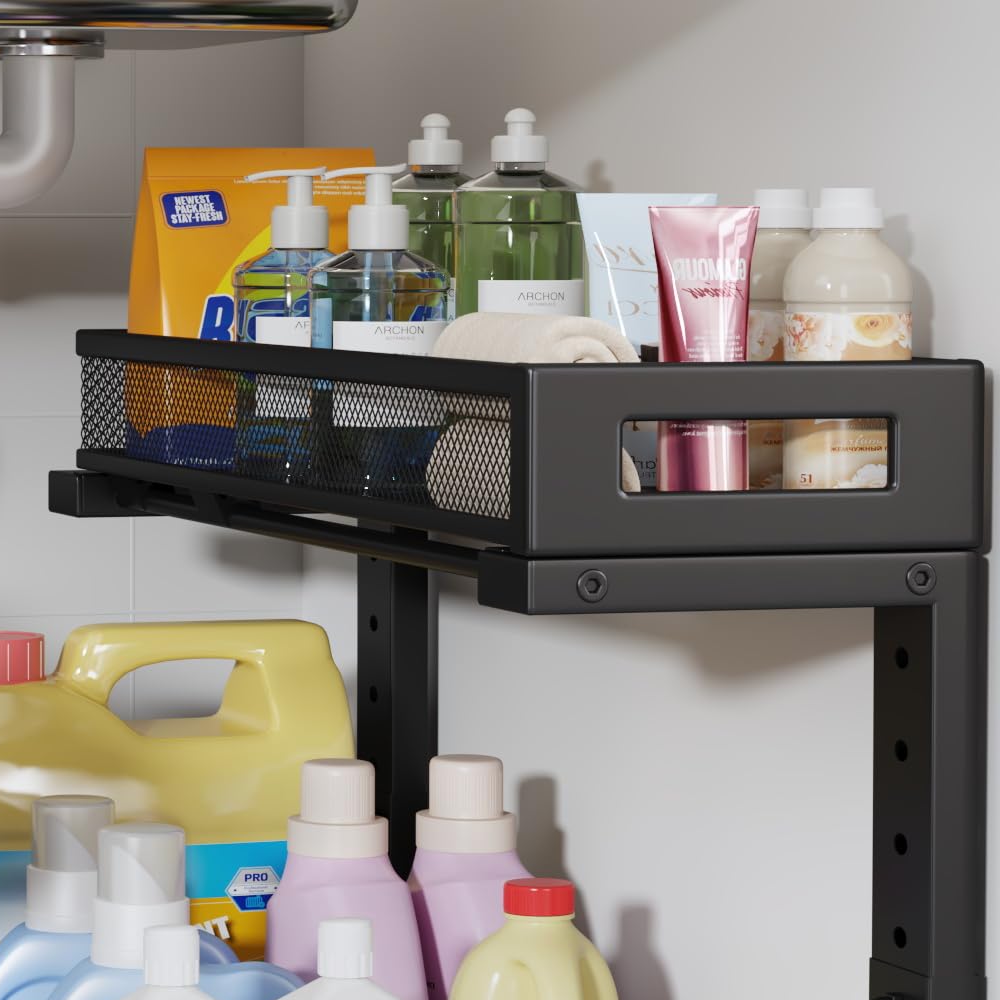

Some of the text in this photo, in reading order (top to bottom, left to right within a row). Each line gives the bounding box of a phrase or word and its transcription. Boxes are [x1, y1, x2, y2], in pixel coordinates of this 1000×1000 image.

[174, 195, 210, 205] NEWEST
[175, 203, 215, 214] PACKAGE
[171, 211, 223, 224] STAY-FRESH
[517, 291, 566, 301] ARCHON
[374, 325, 425, 335] ARCHON
[800, 474, 814, 484] 51
[244, 873, 268, 882] PRO
